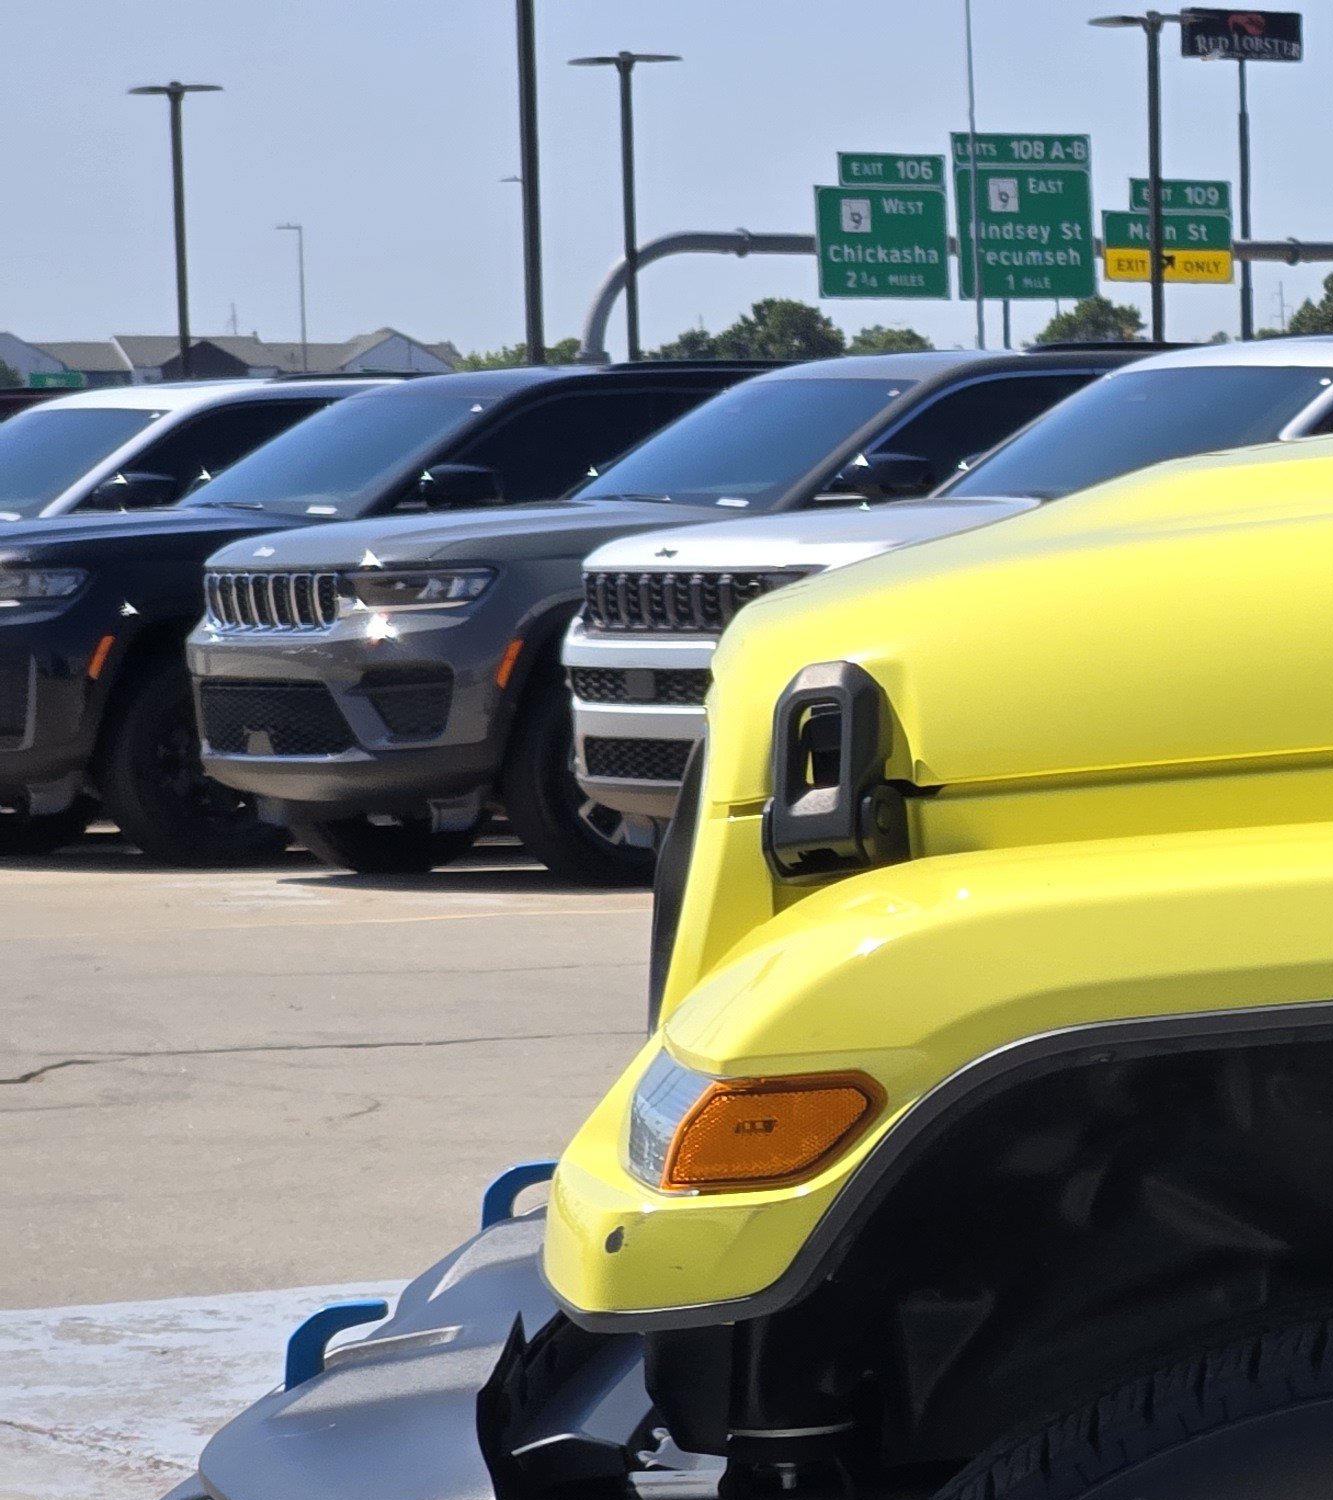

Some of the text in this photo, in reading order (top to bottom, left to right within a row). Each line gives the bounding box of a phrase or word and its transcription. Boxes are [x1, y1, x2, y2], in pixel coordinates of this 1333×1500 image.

[1010, 140, 1045, 160] 108
[1050, 141, 1087, 160] A-B
[851, 160, 934, 180] EXIT 106
[999, 177, 1064, 209] 9 EAST
[1143, 186, 1220, 206] EIT 109
[851, 197, 924, 230] 9 WEST
[1061, 222, 1083, 240] St
[1188, 223, 1209, 242] St
[828, 243, 940, 264] Chickasha
[978, 248, 1082, 266] ecumseh
[1116, 258, 1222, 274] EXIT ONLY
[887, 273, 926, 287] MILES
[1006, 274, 1051, 290] 1 MILE
